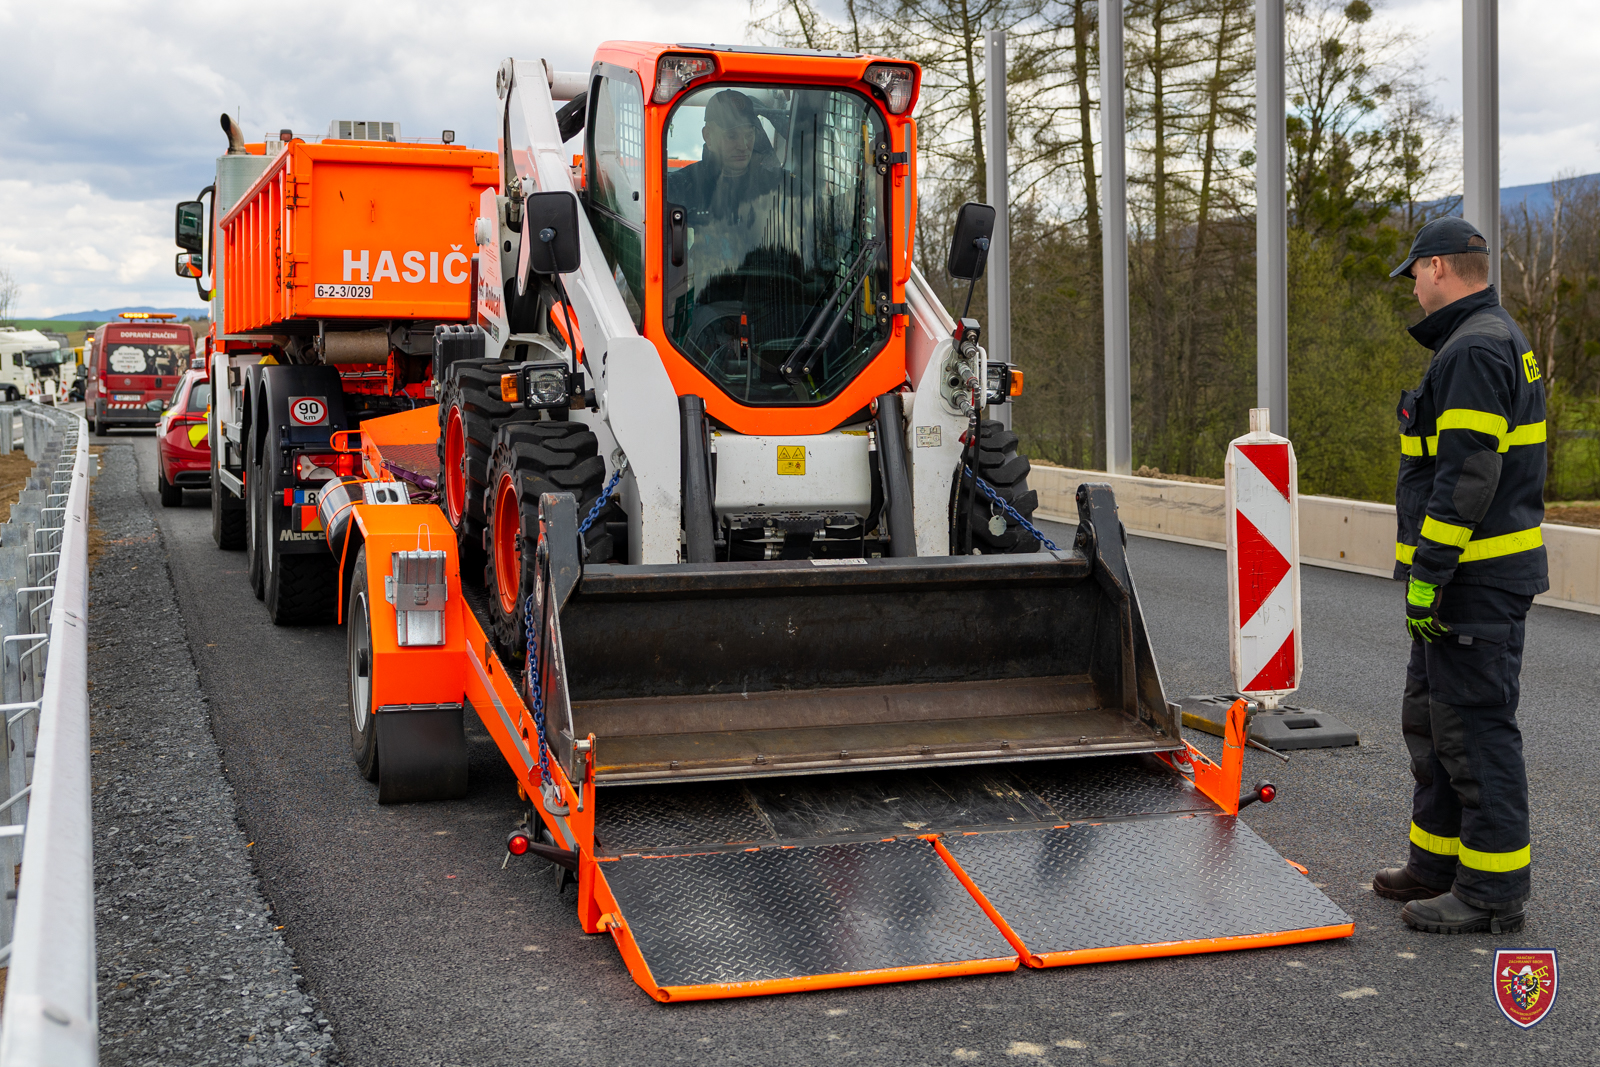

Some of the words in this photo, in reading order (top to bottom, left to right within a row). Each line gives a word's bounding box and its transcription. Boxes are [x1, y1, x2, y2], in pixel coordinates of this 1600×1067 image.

[317, 285, 371, 298] 6-2-3/029
[120, 331, 151, 339] DOPRAVNÍ
[152, 331, 178, 339] ZNAČENÍ
[298, 402, 319, 415] 90
